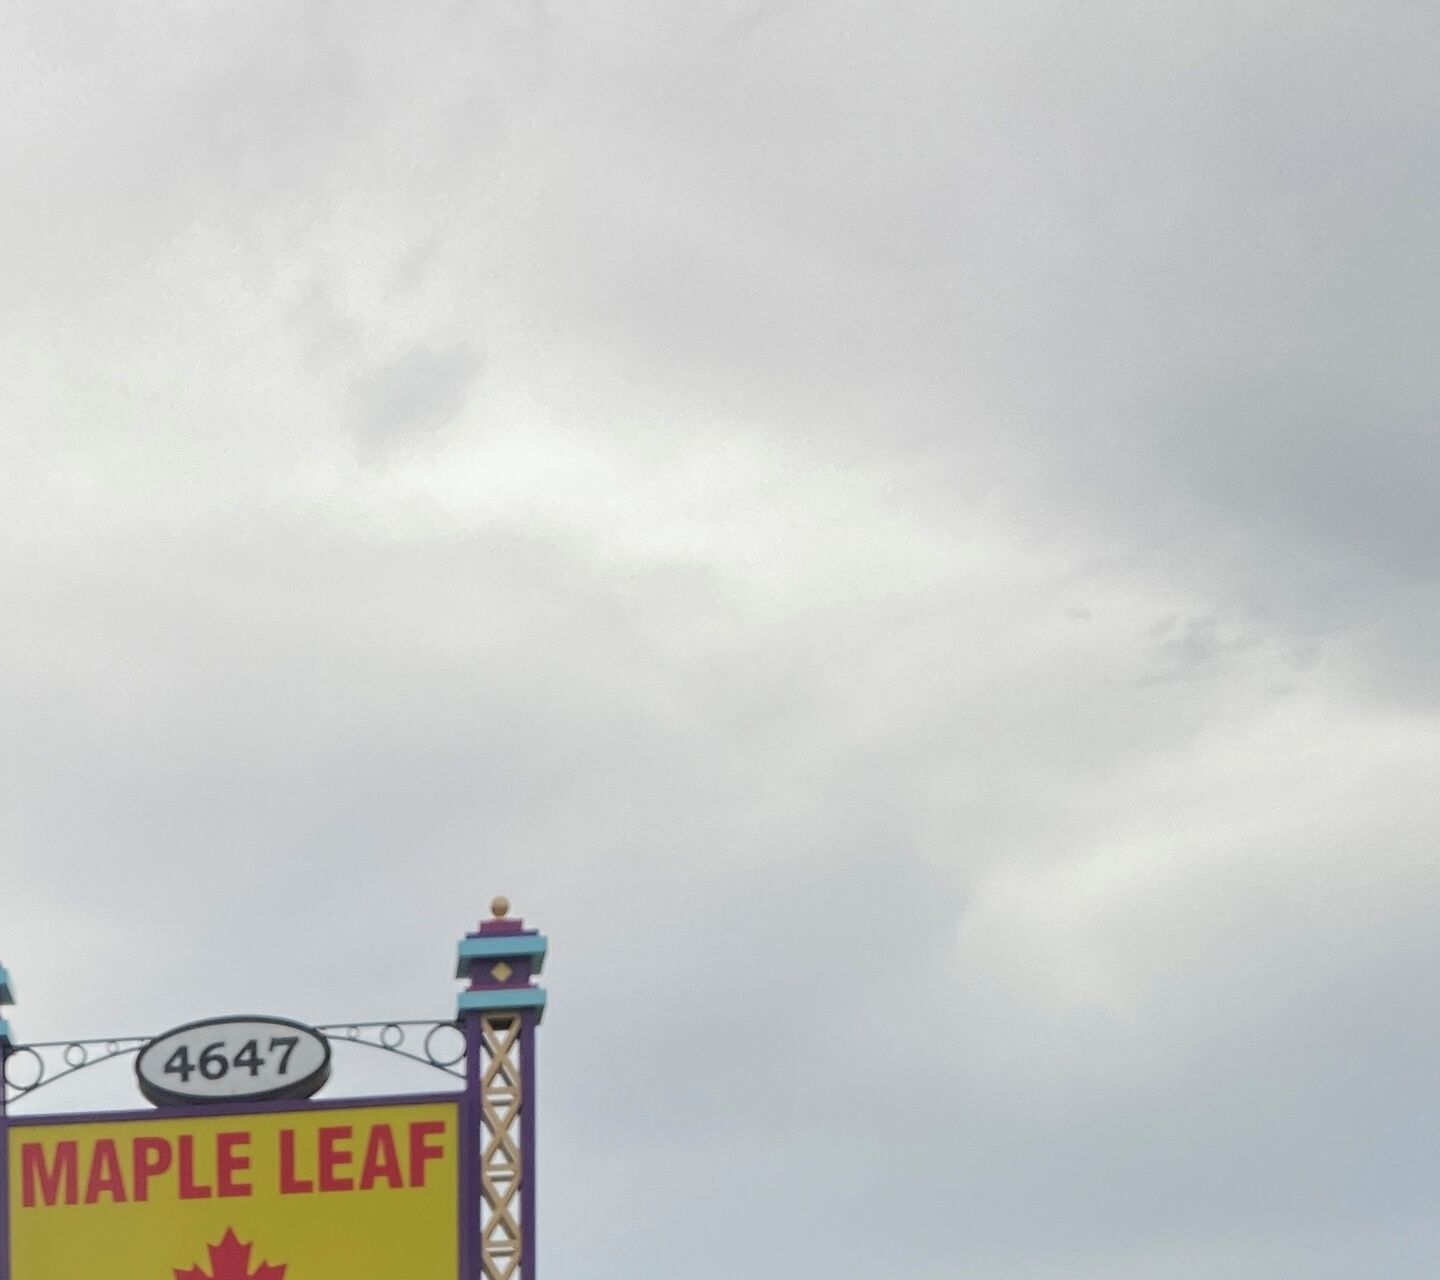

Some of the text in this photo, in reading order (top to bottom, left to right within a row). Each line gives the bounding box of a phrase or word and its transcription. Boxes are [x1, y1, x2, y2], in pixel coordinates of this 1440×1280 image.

[163, 1036, 298, 1082] 4647
[21, 1121, 446, 1208] MAPLE LEAF
